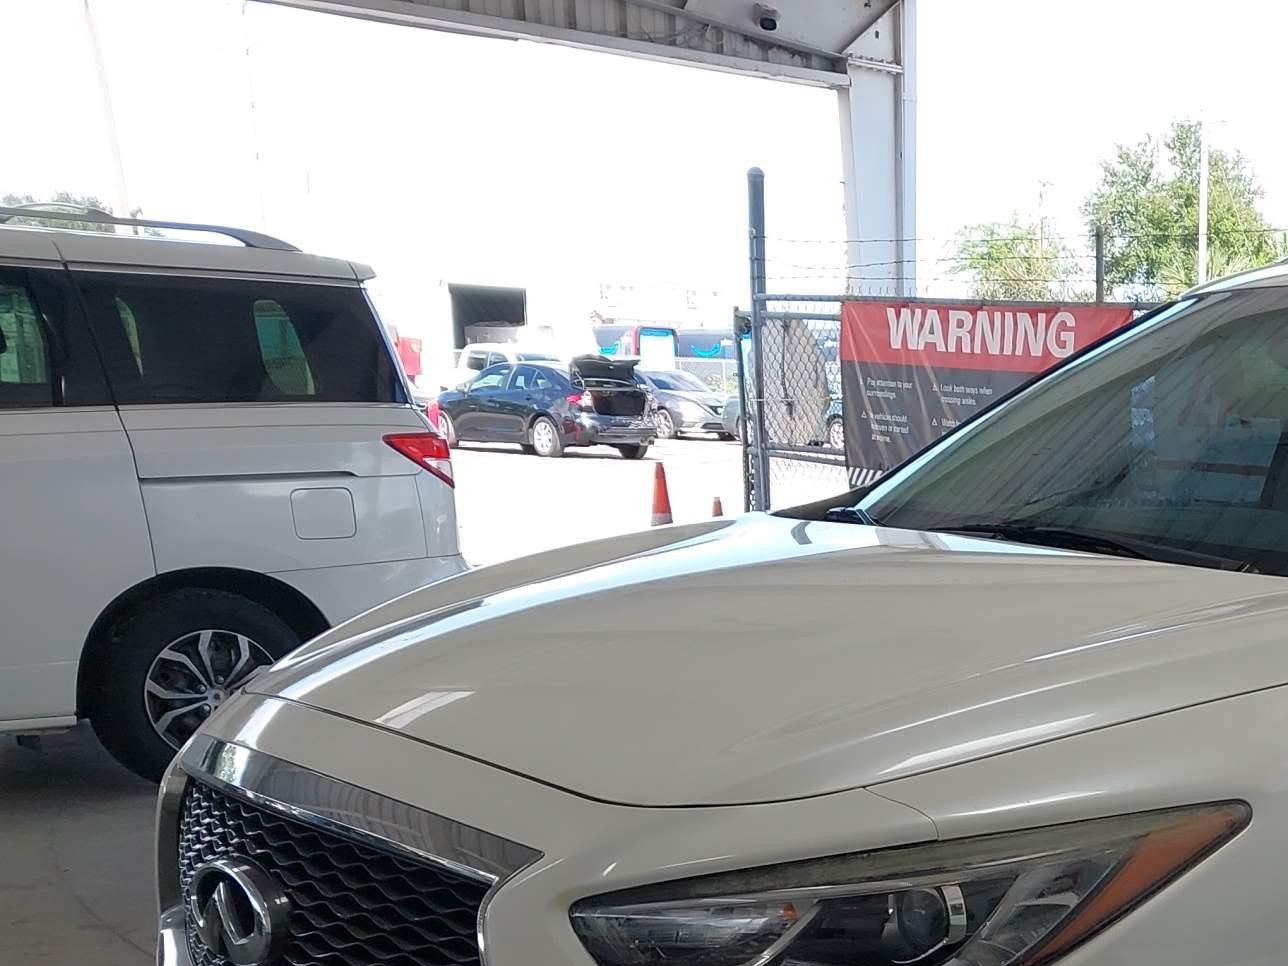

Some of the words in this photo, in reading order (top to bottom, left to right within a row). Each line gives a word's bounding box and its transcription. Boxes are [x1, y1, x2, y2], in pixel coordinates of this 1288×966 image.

[886, 307, 1076, 359] WARNING
[940, 383, 953, 392] Look
[953, 384, 965, 393] both
[965, 386, 978, 395] ways
[979, 386, 993, 395] when
